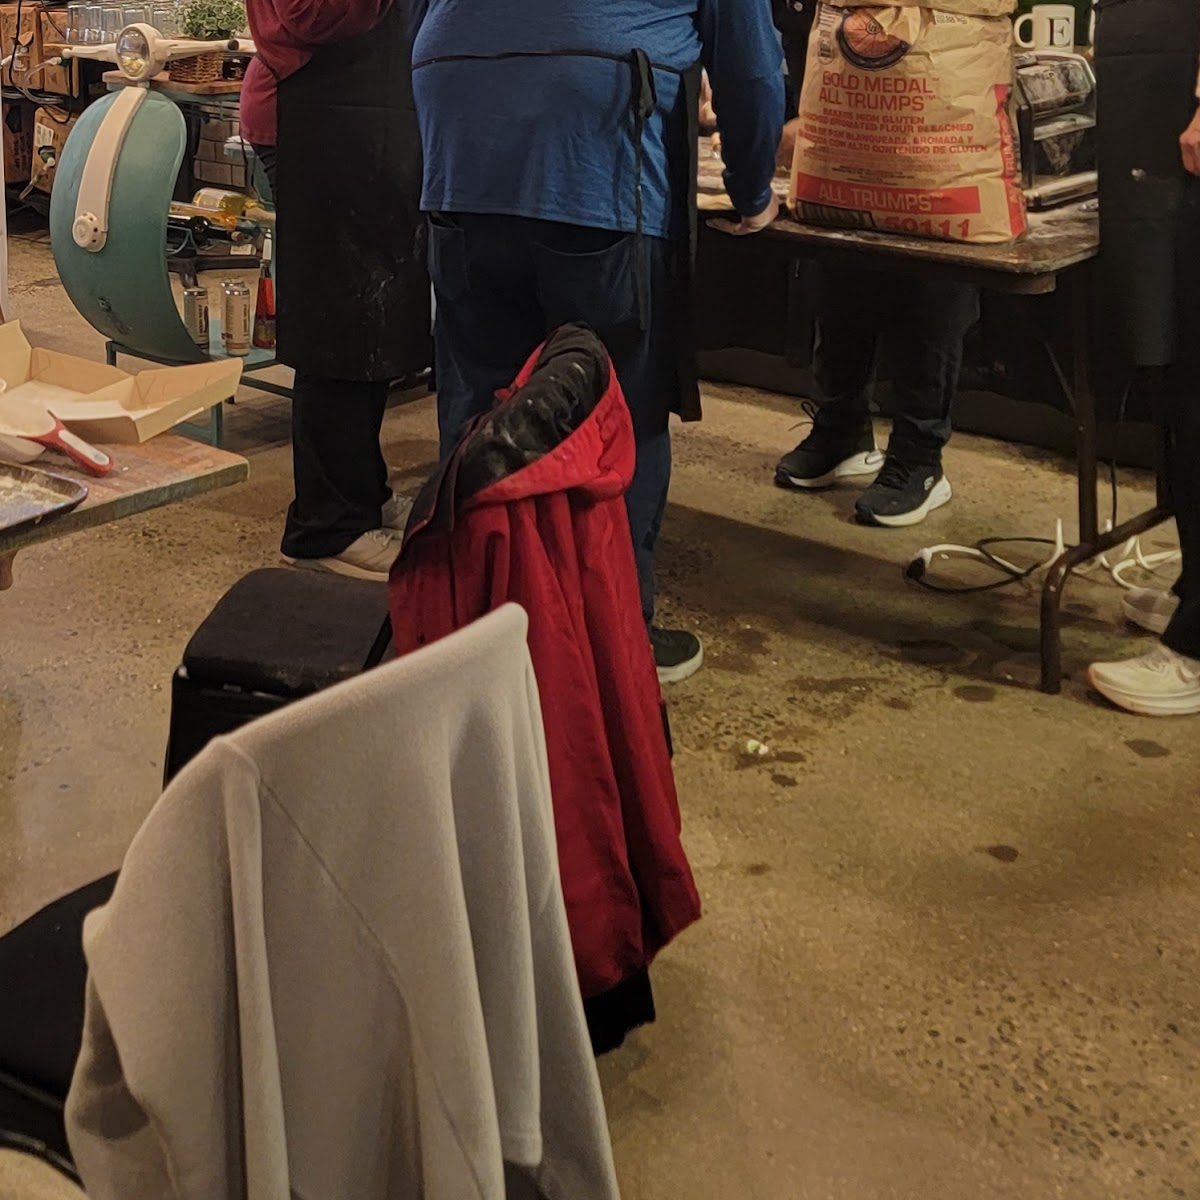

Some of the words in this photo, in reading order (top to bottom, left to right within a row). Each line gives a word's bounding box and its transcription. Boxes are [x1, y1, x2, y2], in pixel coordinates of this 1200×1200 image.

[1046, 16, 1071, 47] E
[822, 70, 860, 90] GOLD
[864, 76, 933, 94] MEDAL
[819, 87, 843, 105] ALL
[845, 91, 925, 112] TRUMPS
[855, 112, 879, 124] HIGH
[883, 115, 925, 125] GLUTEN
[880, 123, 914, 133] FLOUR
[918, 123, 974, 133] BLEACHED
[872, 143, 931, 155] CONTENIDO
[933, 144, 947, 155] DE
[948, 143, 988, 154] GLUTEN
[913, 135, 965, 145] BROMADA
[967, 135, 974, 144] Y
[818, 183, 842, 203] ALL
[850, 188, 932, 212] TRUMPS
